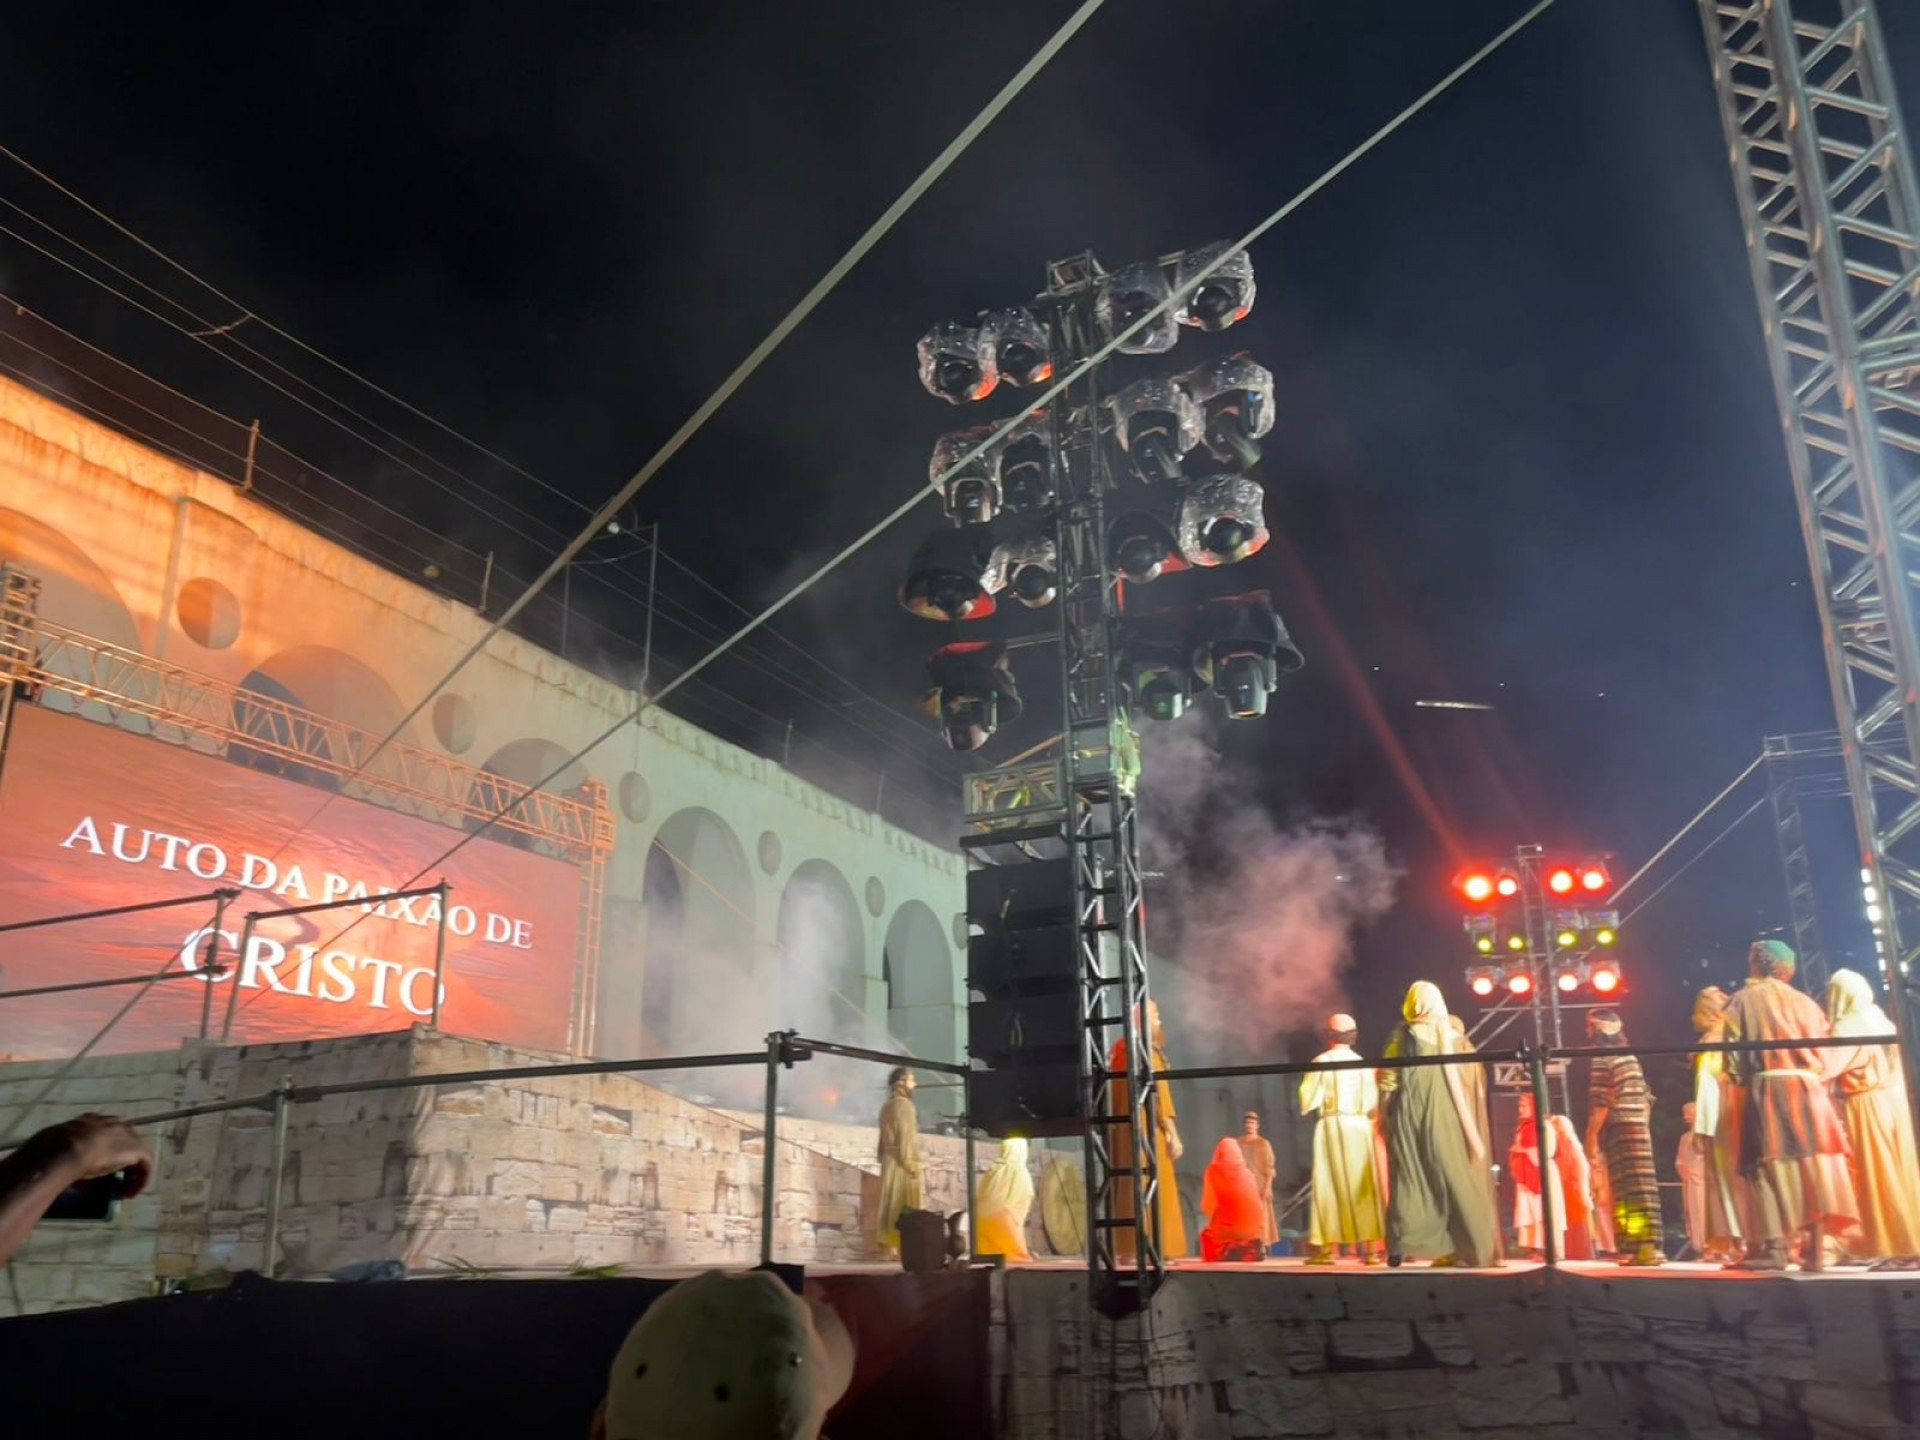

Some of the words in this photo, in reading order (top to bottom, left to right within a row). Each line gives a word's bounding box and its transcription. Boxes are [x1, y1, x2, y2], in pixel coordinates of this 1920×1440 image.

[59, 816, 227, 879] AUTO
[237, 853, 312, 900] DA
[484, 912, 534, 949] DE
[180, 927, 446, 1016] CRISTO
